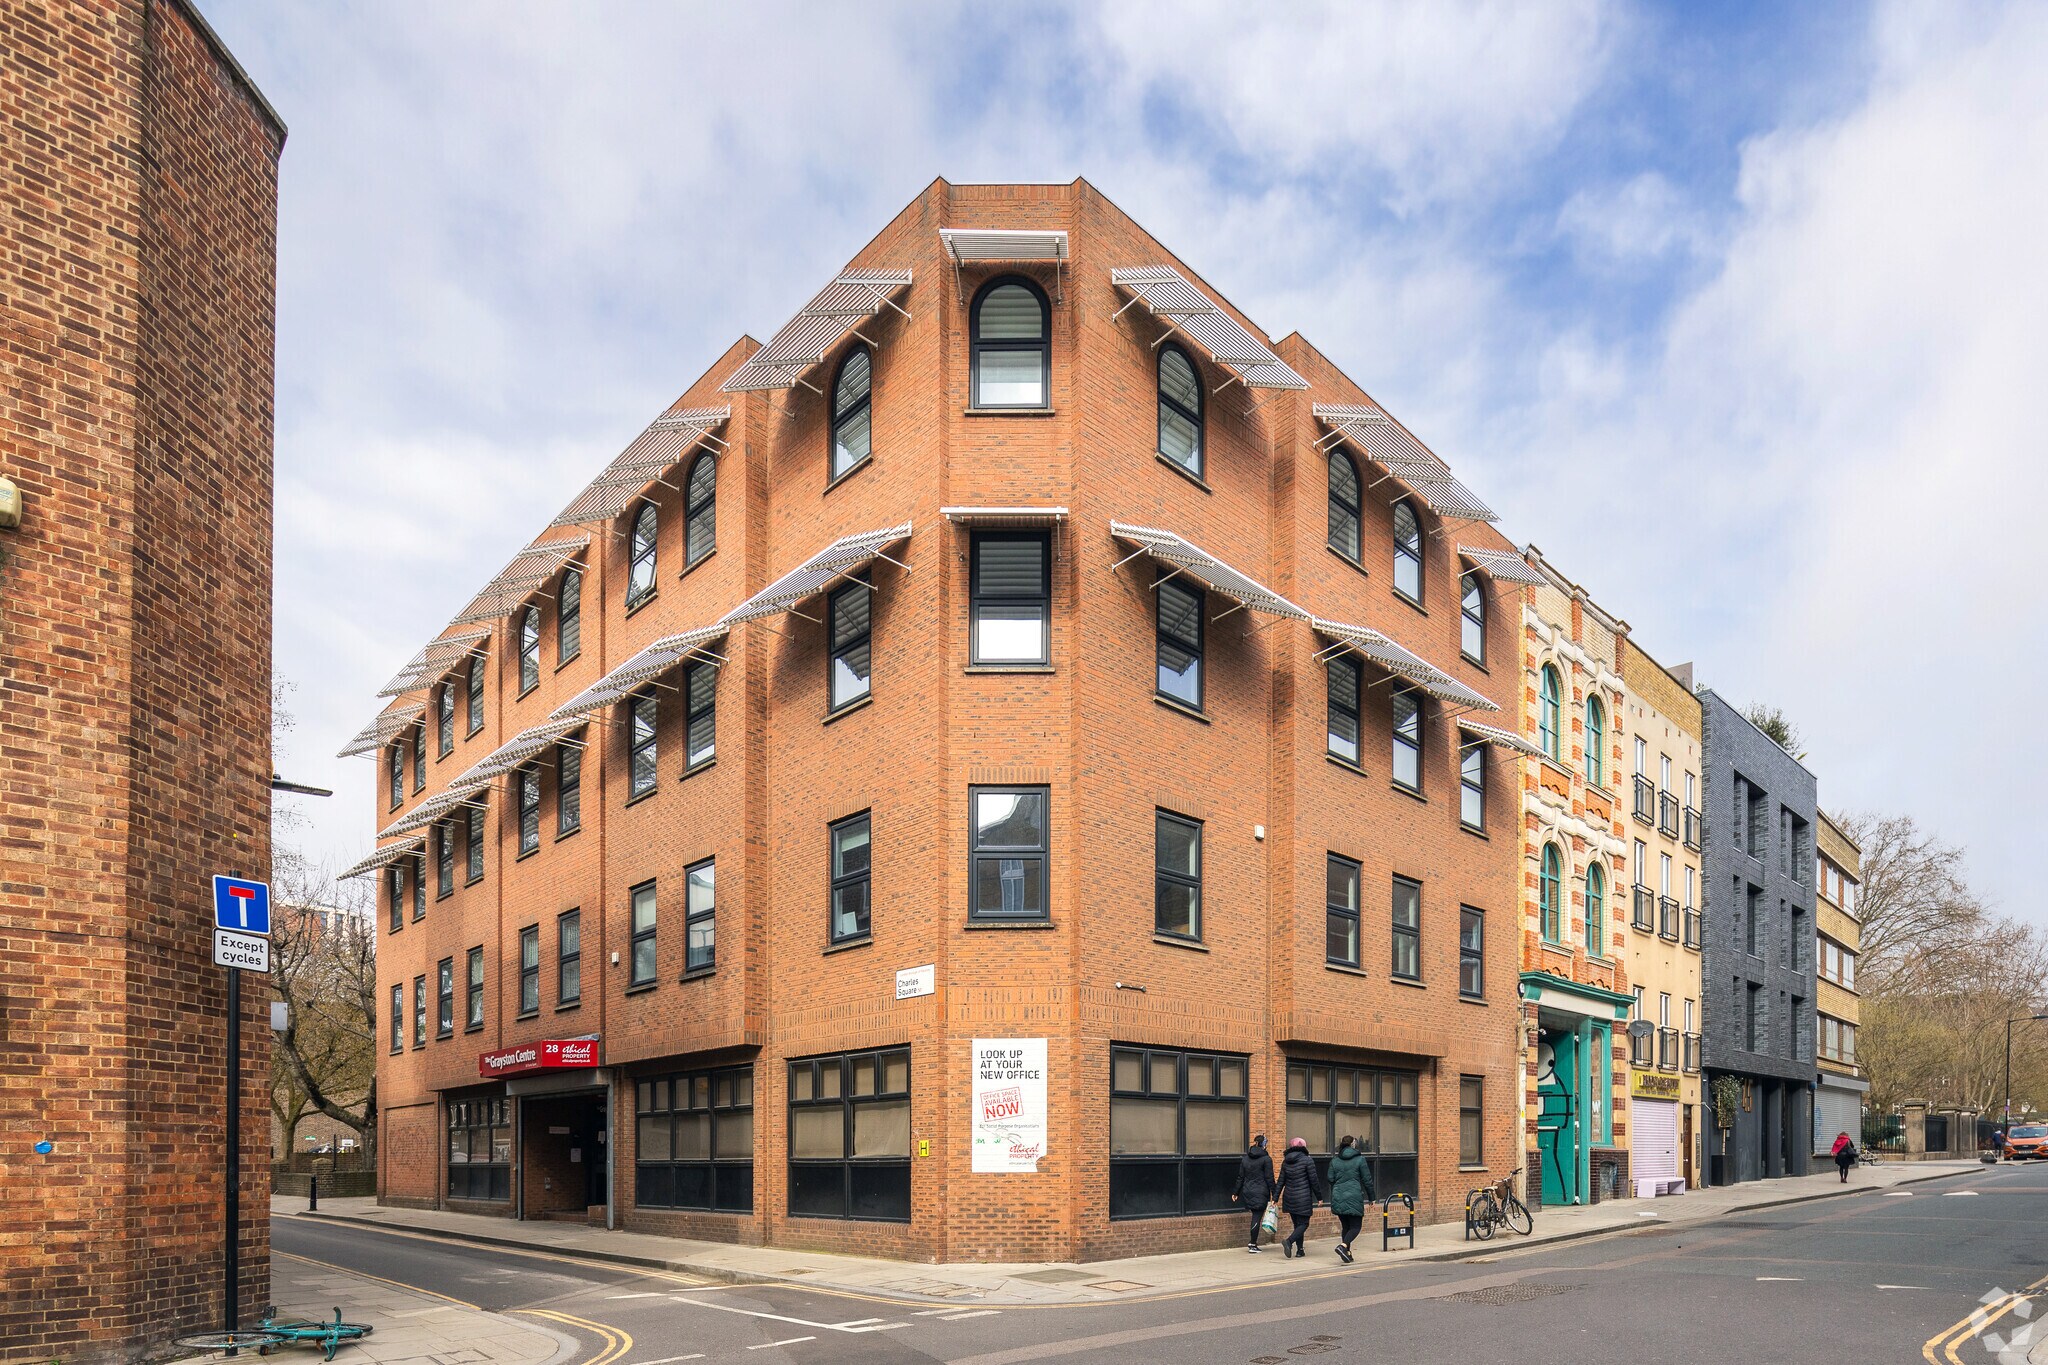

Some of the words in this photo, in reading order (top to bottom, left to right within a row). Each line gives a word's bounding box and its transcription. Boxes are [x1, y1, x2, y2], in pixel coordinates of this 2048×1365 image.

[221, 936, 264, 953] Except
[222, 951, 262, 966] cycles
[897, 979, 918, 988] Charles
[897, 988, 917, 996] Square
[545, 1044, 559, 1053] 28
[562, 1043, 591, 1053] ethical
[490, 1054, 515, 1069] Grayston
[516, 1049, 536, 1063] Centre
[980, 1049, 1006, 1059] LOOK
[1009, 1049, 1023, 1059] UP
[980, 1059, 993, 1069] AT
[995, 1059, 1023, 1069] YOUR
[980, 1070, 1004, 1080] NEW
[1006, 1070, 1040, 1080] OFFICE
[984, 1094, 1019, 1107] AVAILABLE
[985, 1101, 1019, 1119] NOW
[1009, 1142, 1040, 1153] ethical
